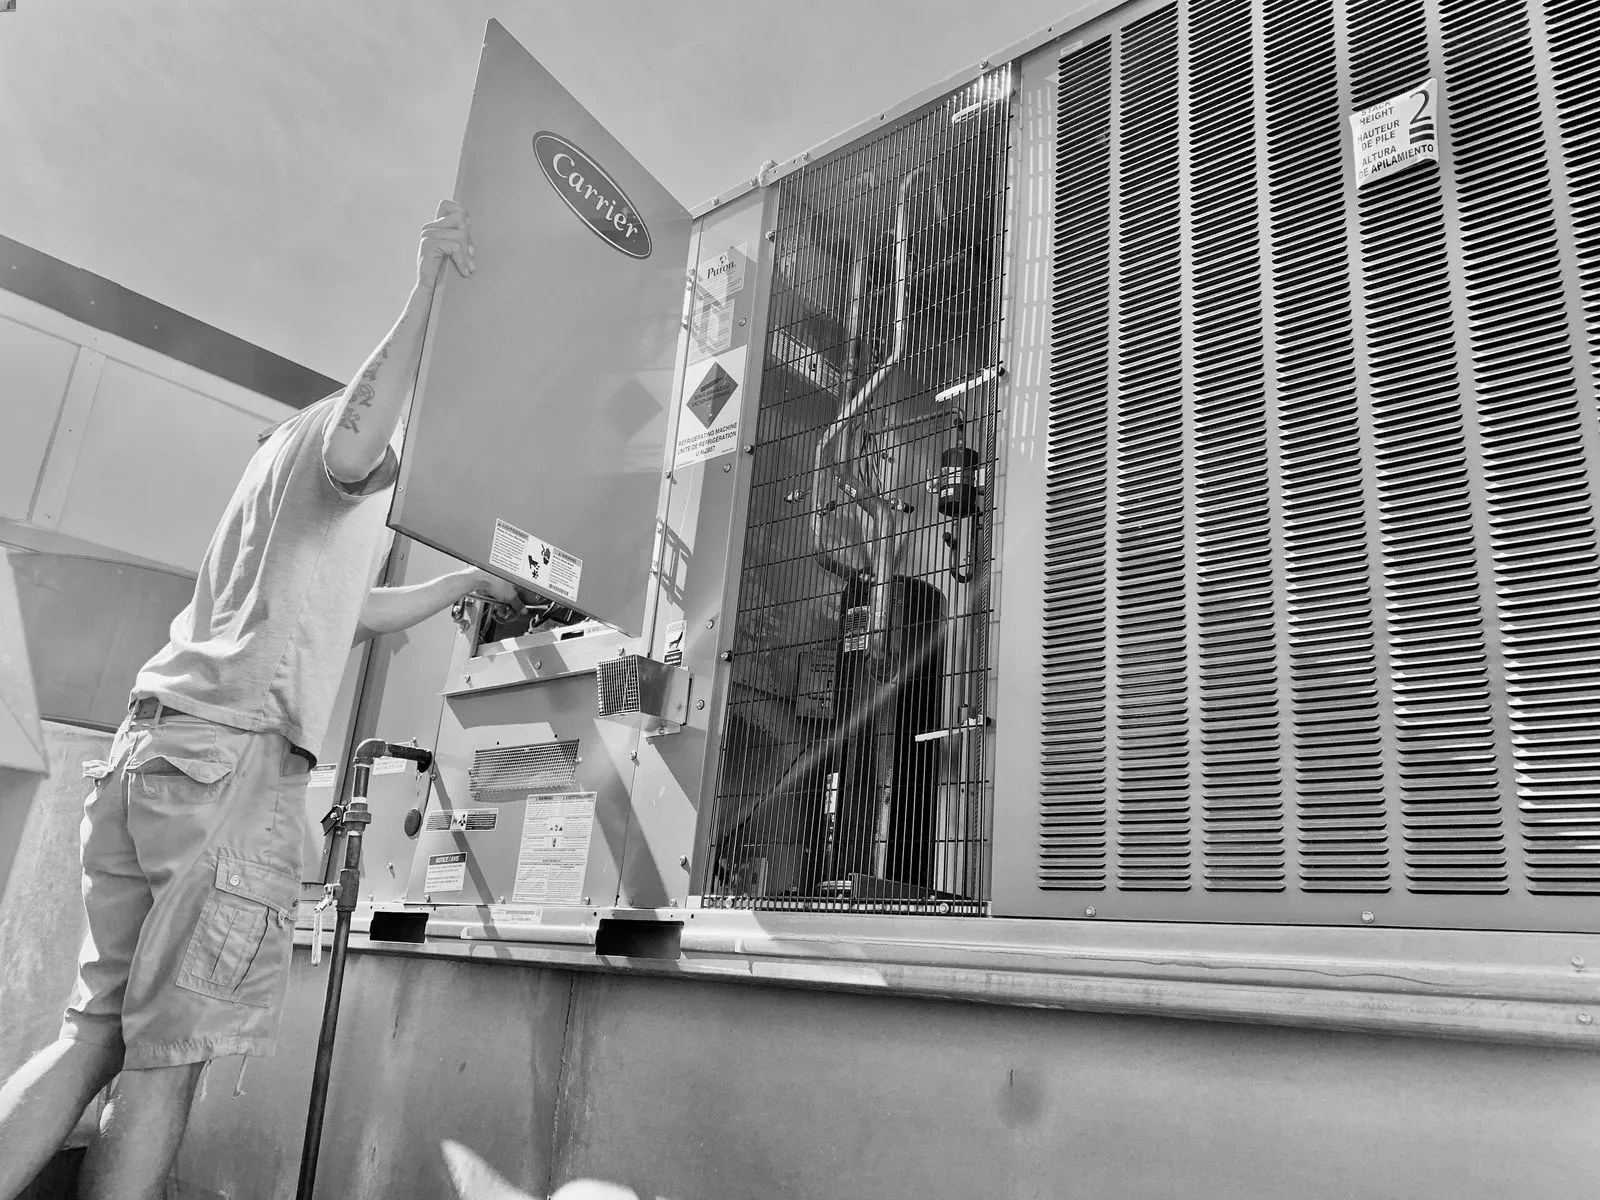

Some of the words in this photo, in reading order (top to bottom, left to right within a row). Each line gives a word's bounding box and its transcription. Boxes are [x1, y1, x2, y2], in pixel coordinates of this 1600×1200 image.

[1360, 106, 1395, 125] HEIGHT
[1361, 100, 1391, 116] STACK
[1409, 89, 1432, 125] 2
[1357, 119, 1400, 143] HAUTEUR
[1361, 139, 1373, 151] DE
[1375, 130, 1396, 145] PILE
[1362, 145, 1397, 167] ALTURA
[1371, 143, 1434, 173] APILAMIENTO
[552, 152, 638, 238] Carrier
[715, 422, 737, 433] MACHINE
